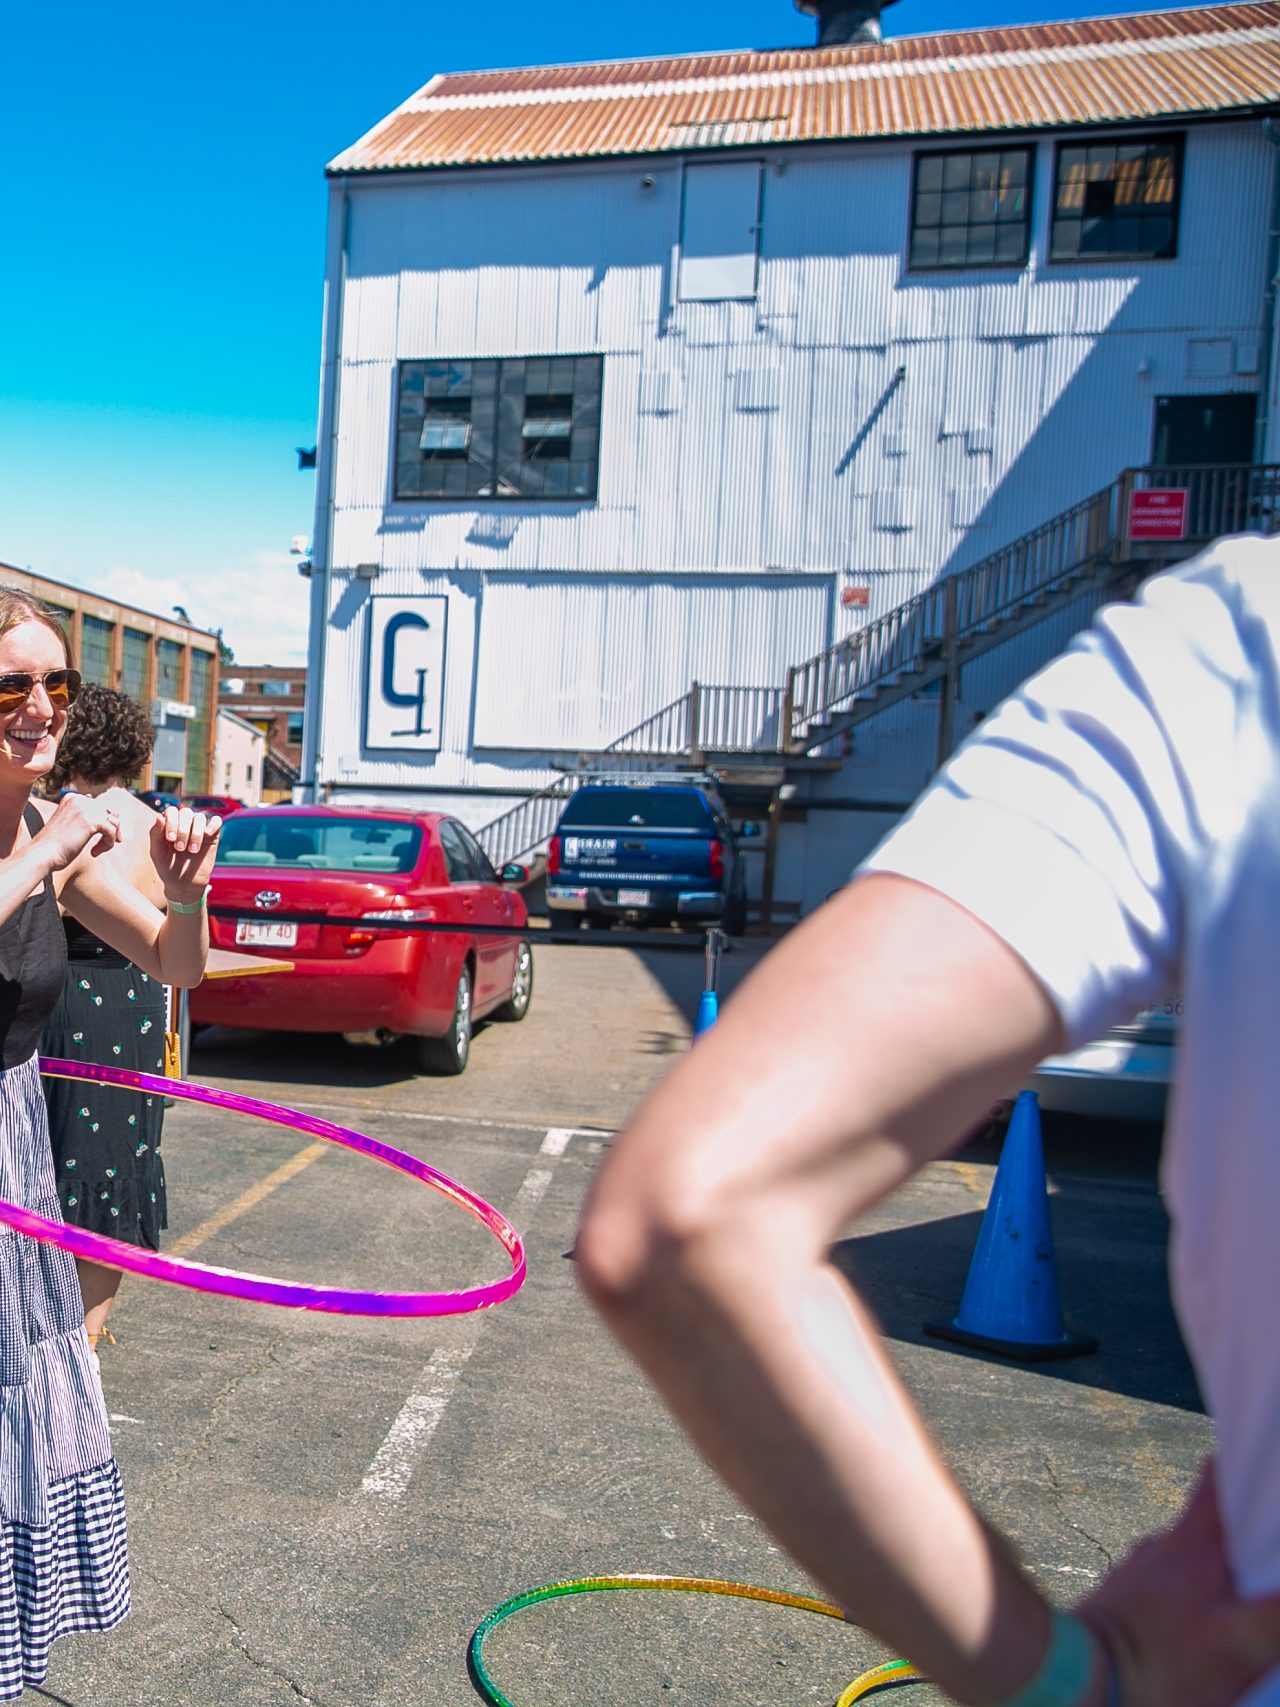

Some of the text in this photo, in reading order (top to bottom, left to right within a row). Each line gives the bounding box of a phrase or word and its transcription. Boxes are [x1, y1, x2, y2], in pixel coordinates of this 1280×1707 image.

[1148, 494, 1169, 504] FIRE
[1132, 506, 1183, 516] DEPARTMENT
[1131, 518, 1182, 528] CONNECTION
